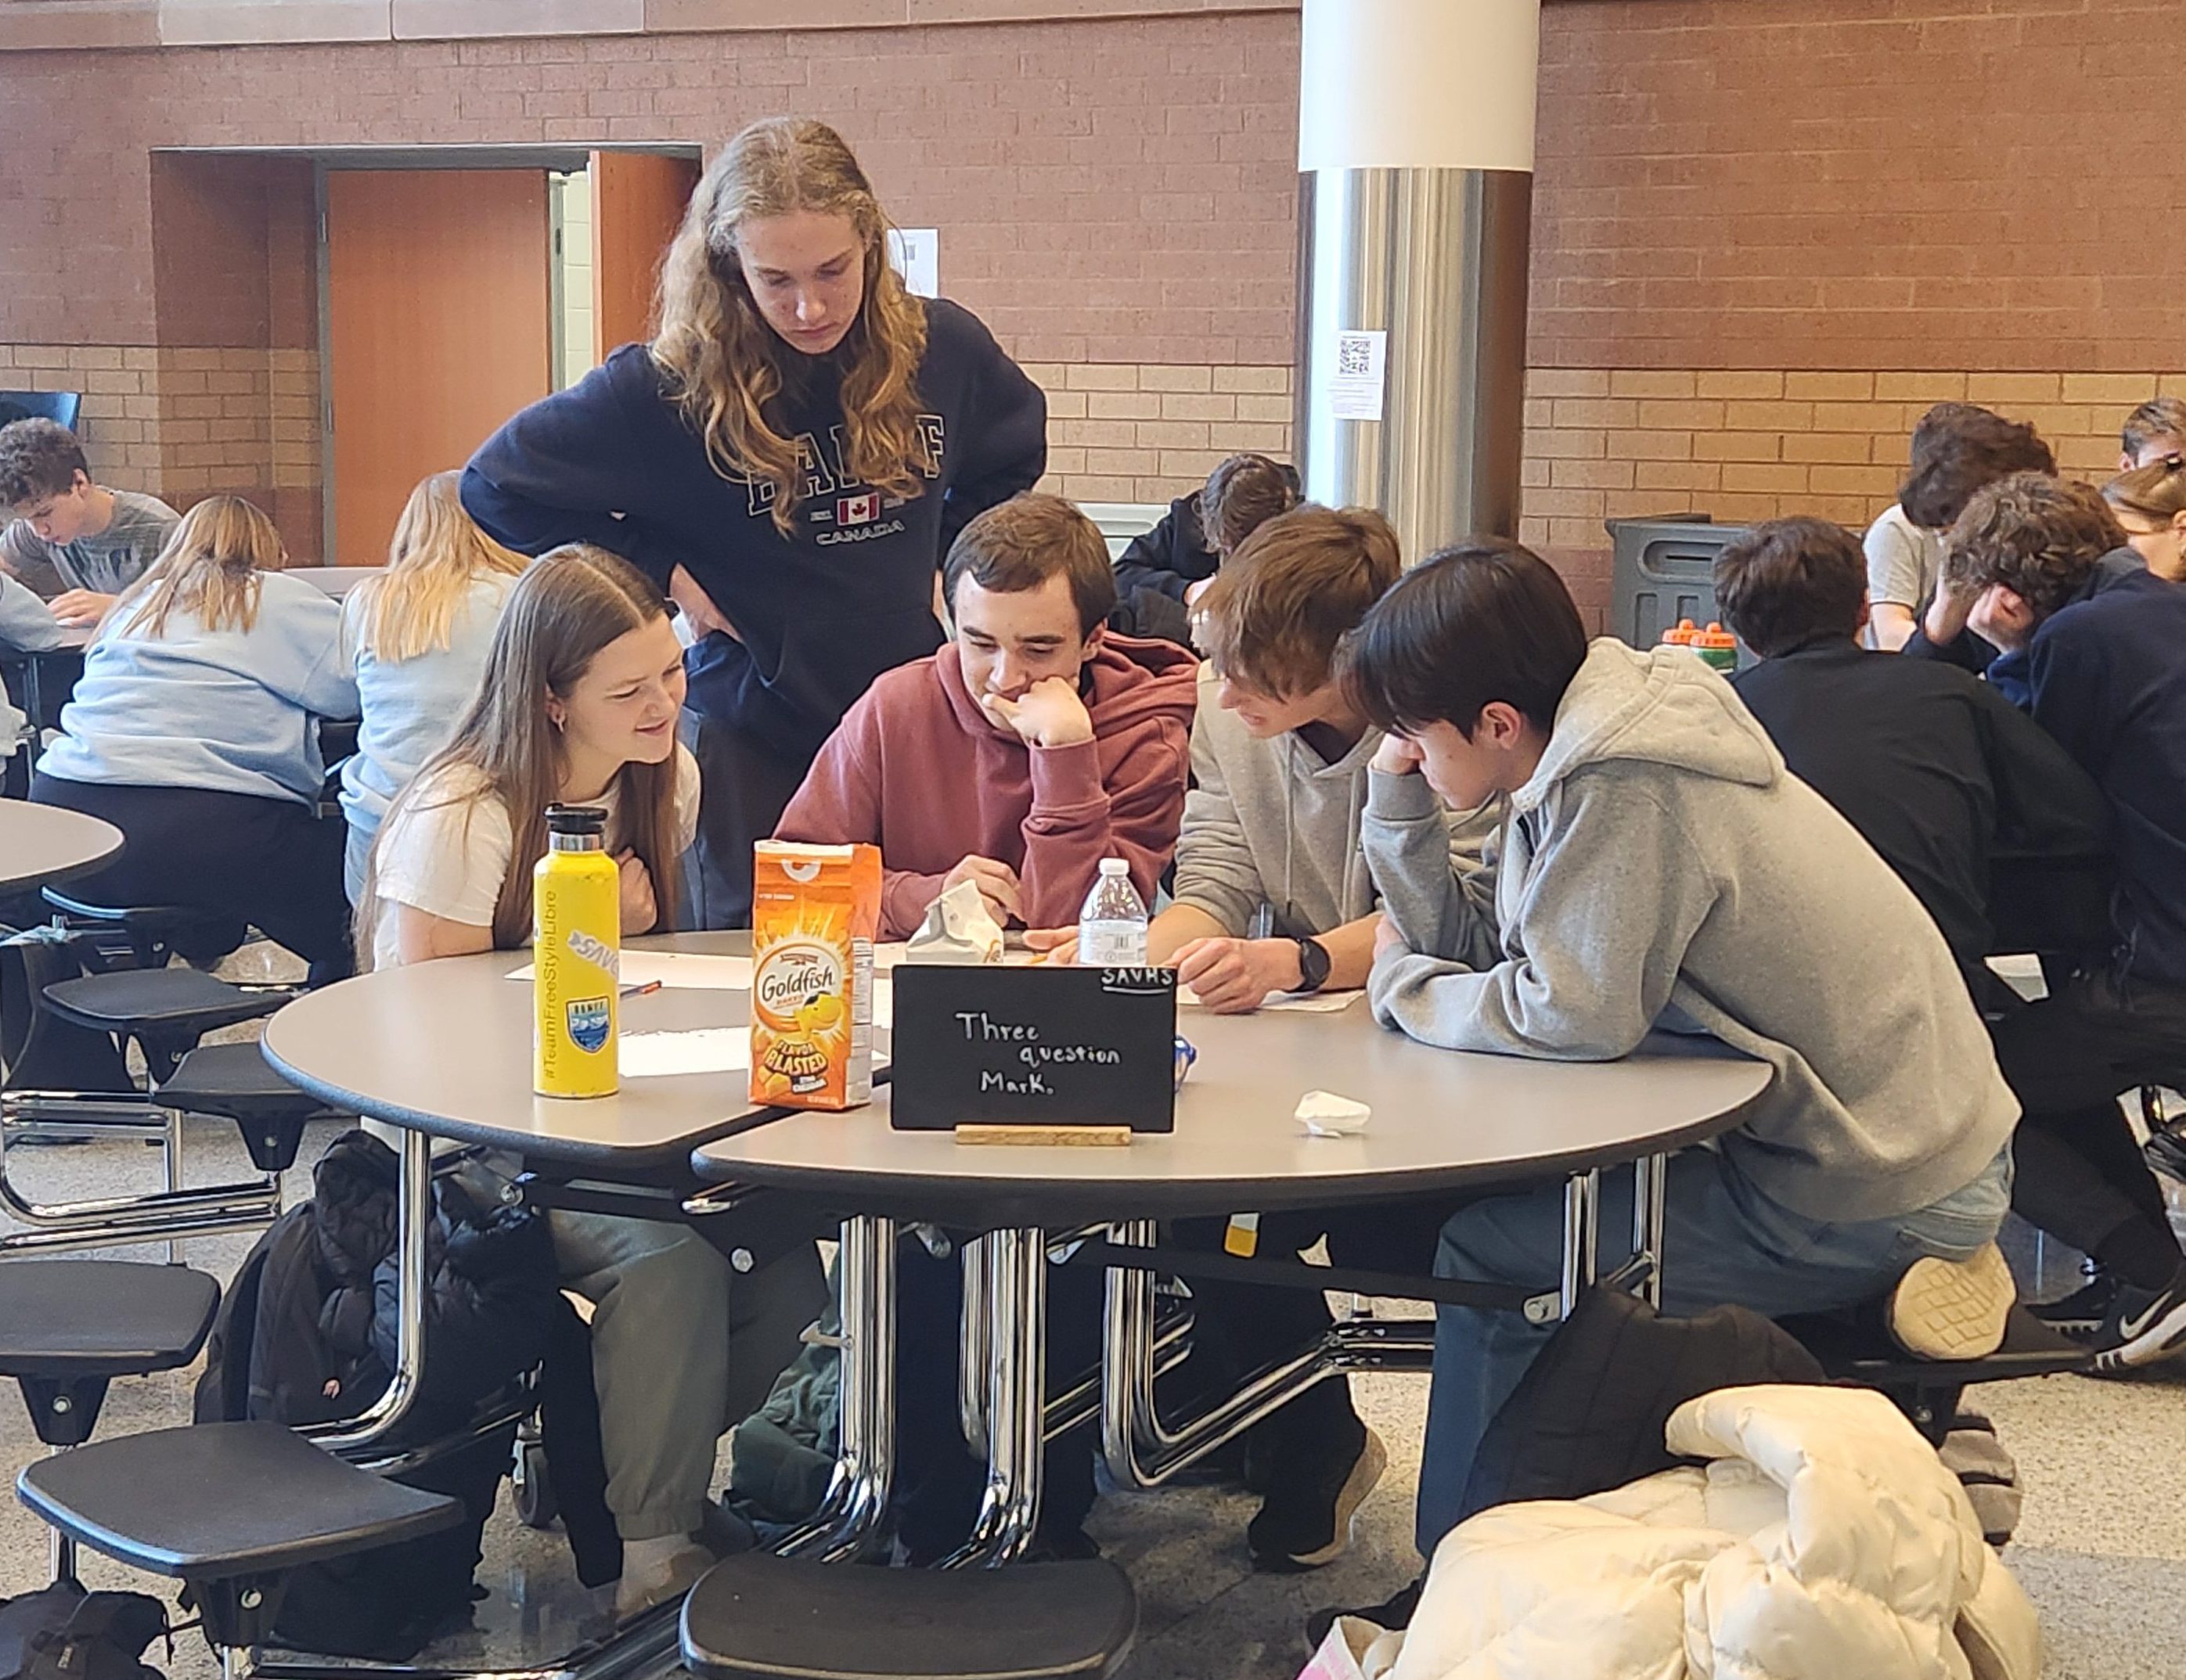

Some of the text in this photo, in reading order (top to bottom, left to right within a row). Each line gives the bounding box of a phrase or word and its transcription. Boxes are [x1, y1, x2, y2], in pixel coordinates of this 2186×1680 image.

[816, 519, 906, 545] CANADA
[762, 965, 833, 1002] Goldfish
[955, 1012, 1039, 1041] Three
[764, 1049, 827, 1077] BLASTED
[1019, 1045, 1120, 1069] question
